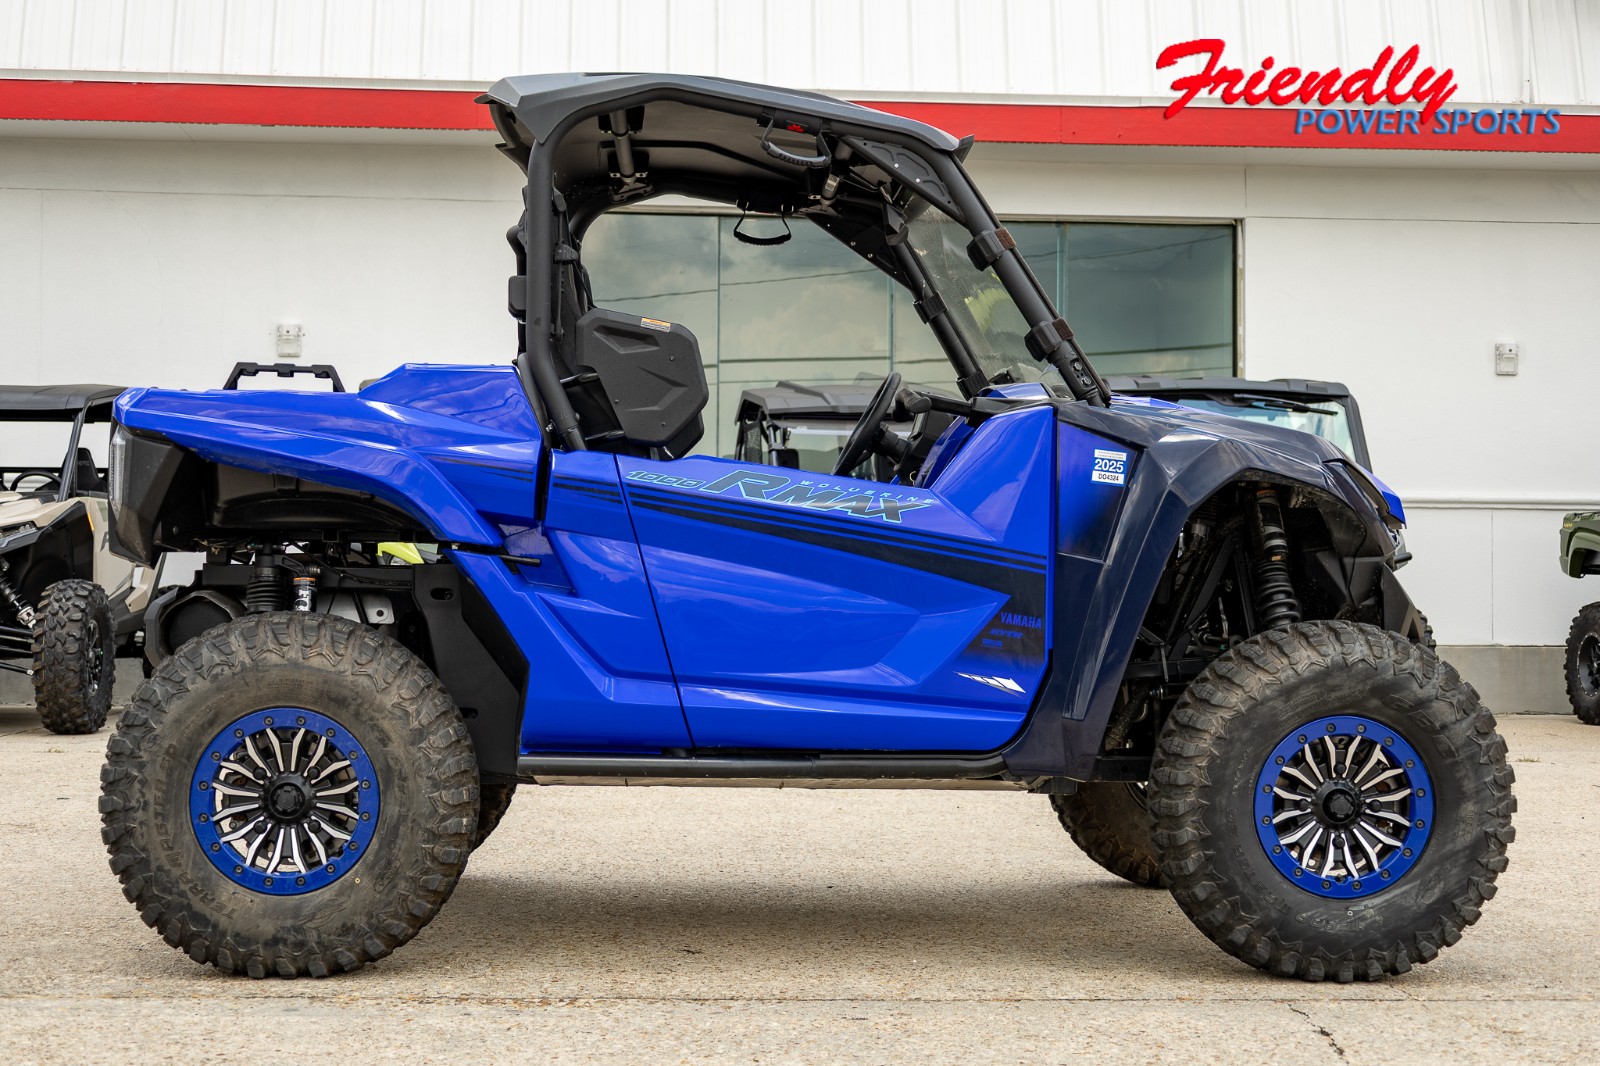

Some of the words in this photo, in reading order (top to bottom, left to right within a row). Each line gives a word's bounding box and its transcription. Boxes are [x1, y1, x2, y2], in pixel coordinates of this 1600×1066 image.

[1094, 458, 1124, 473] 2025
[698, 469, 932, 524] RMAX
[1000, 611, 1042, 630] YAMAHA
[153, 777, 183, 869] MASTER
[187, 869, 238, 921] TERRA
